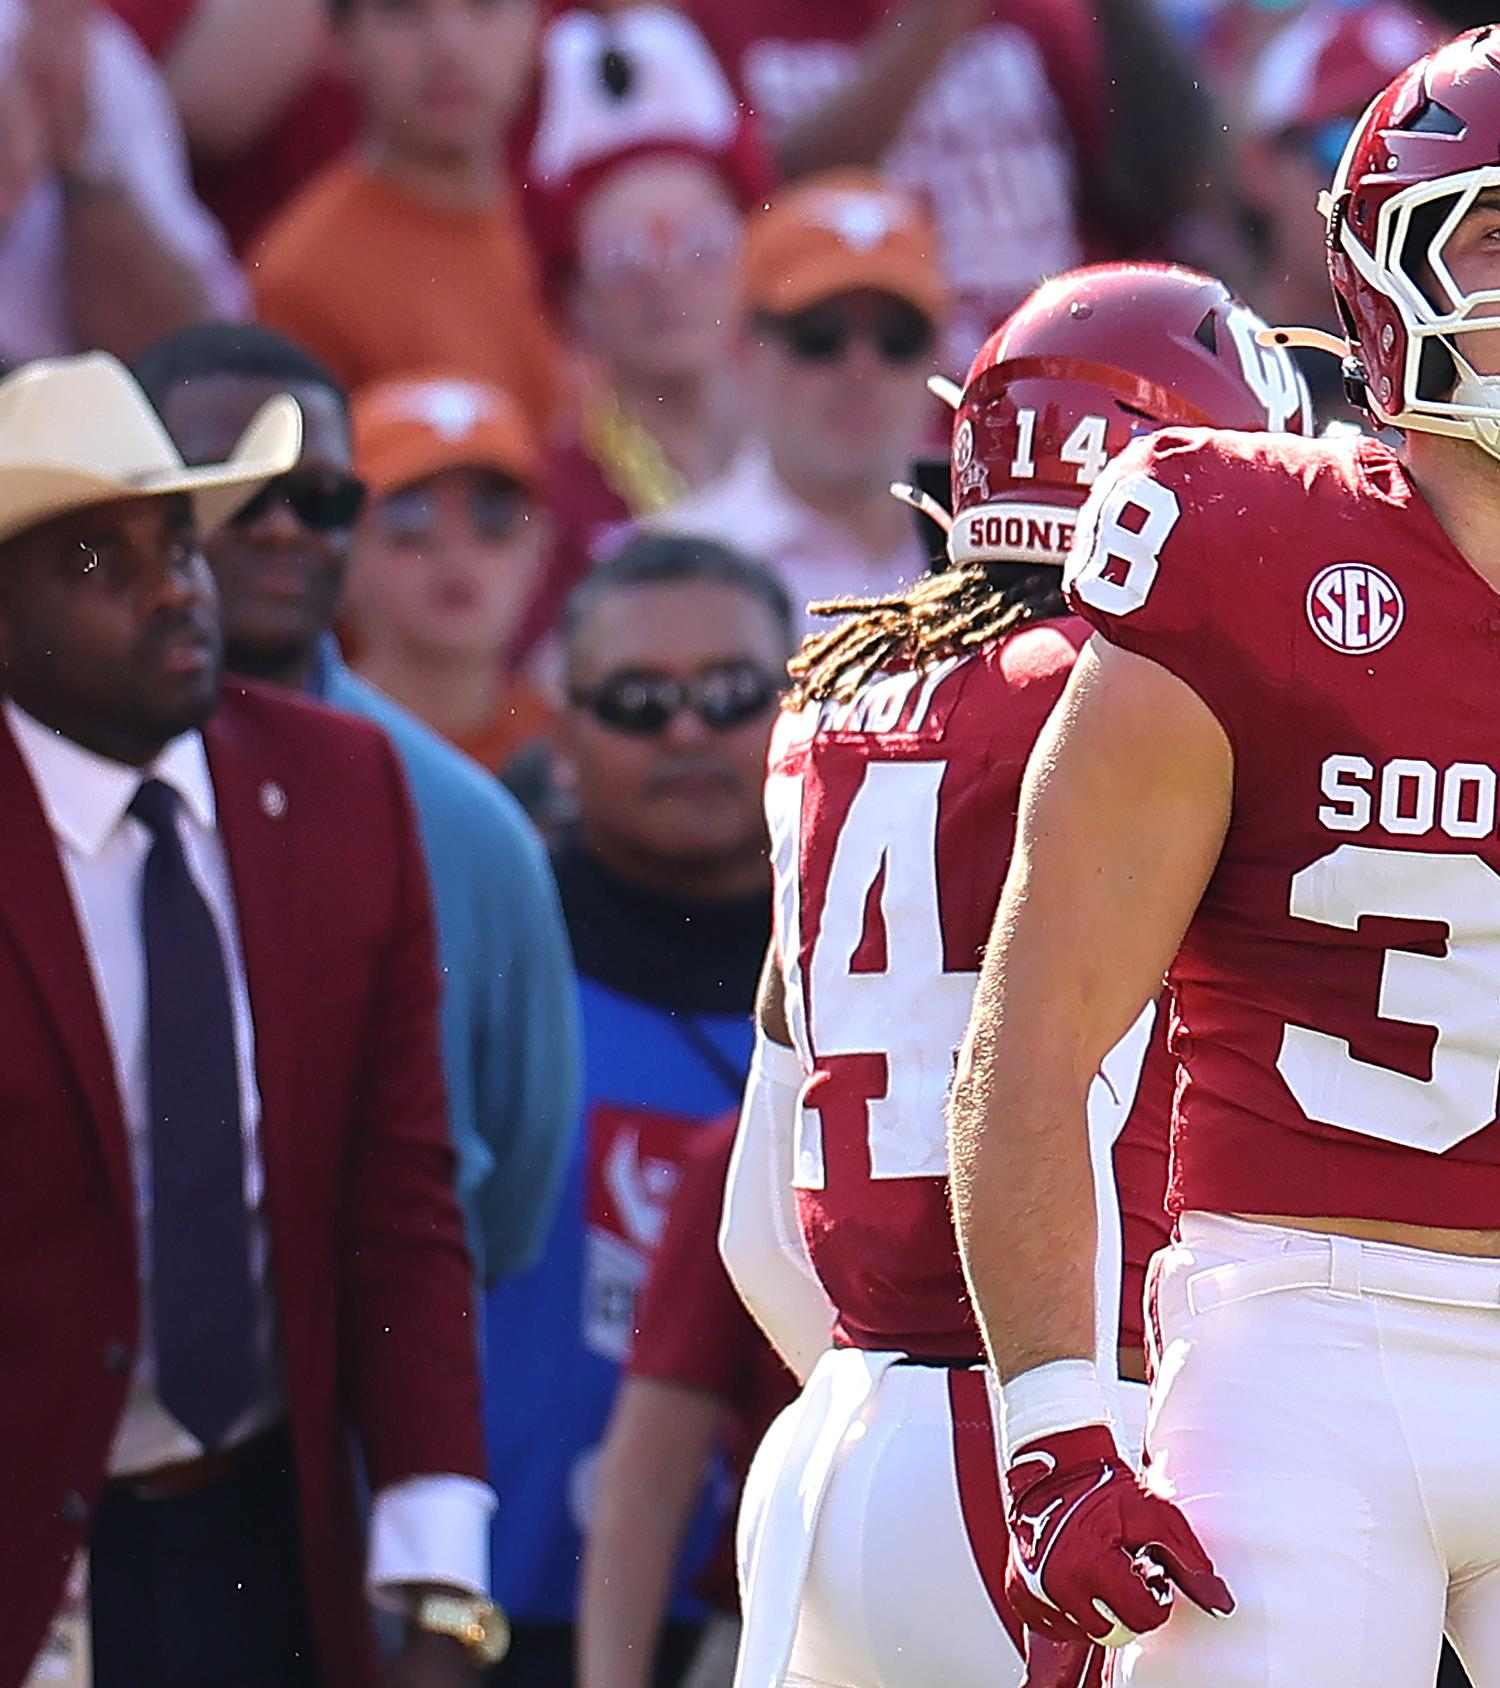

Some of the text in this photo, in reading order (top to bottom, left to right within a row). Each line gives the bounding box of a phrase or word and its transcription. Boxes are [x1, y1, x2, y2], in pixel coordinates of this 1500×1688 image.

[1011, 409, 1108, 485] 14
[970, 517, 1077, 552] SOONE
[1064, 472, 1182, 616] 8
[1314, 568, 1396, 648] SEC
